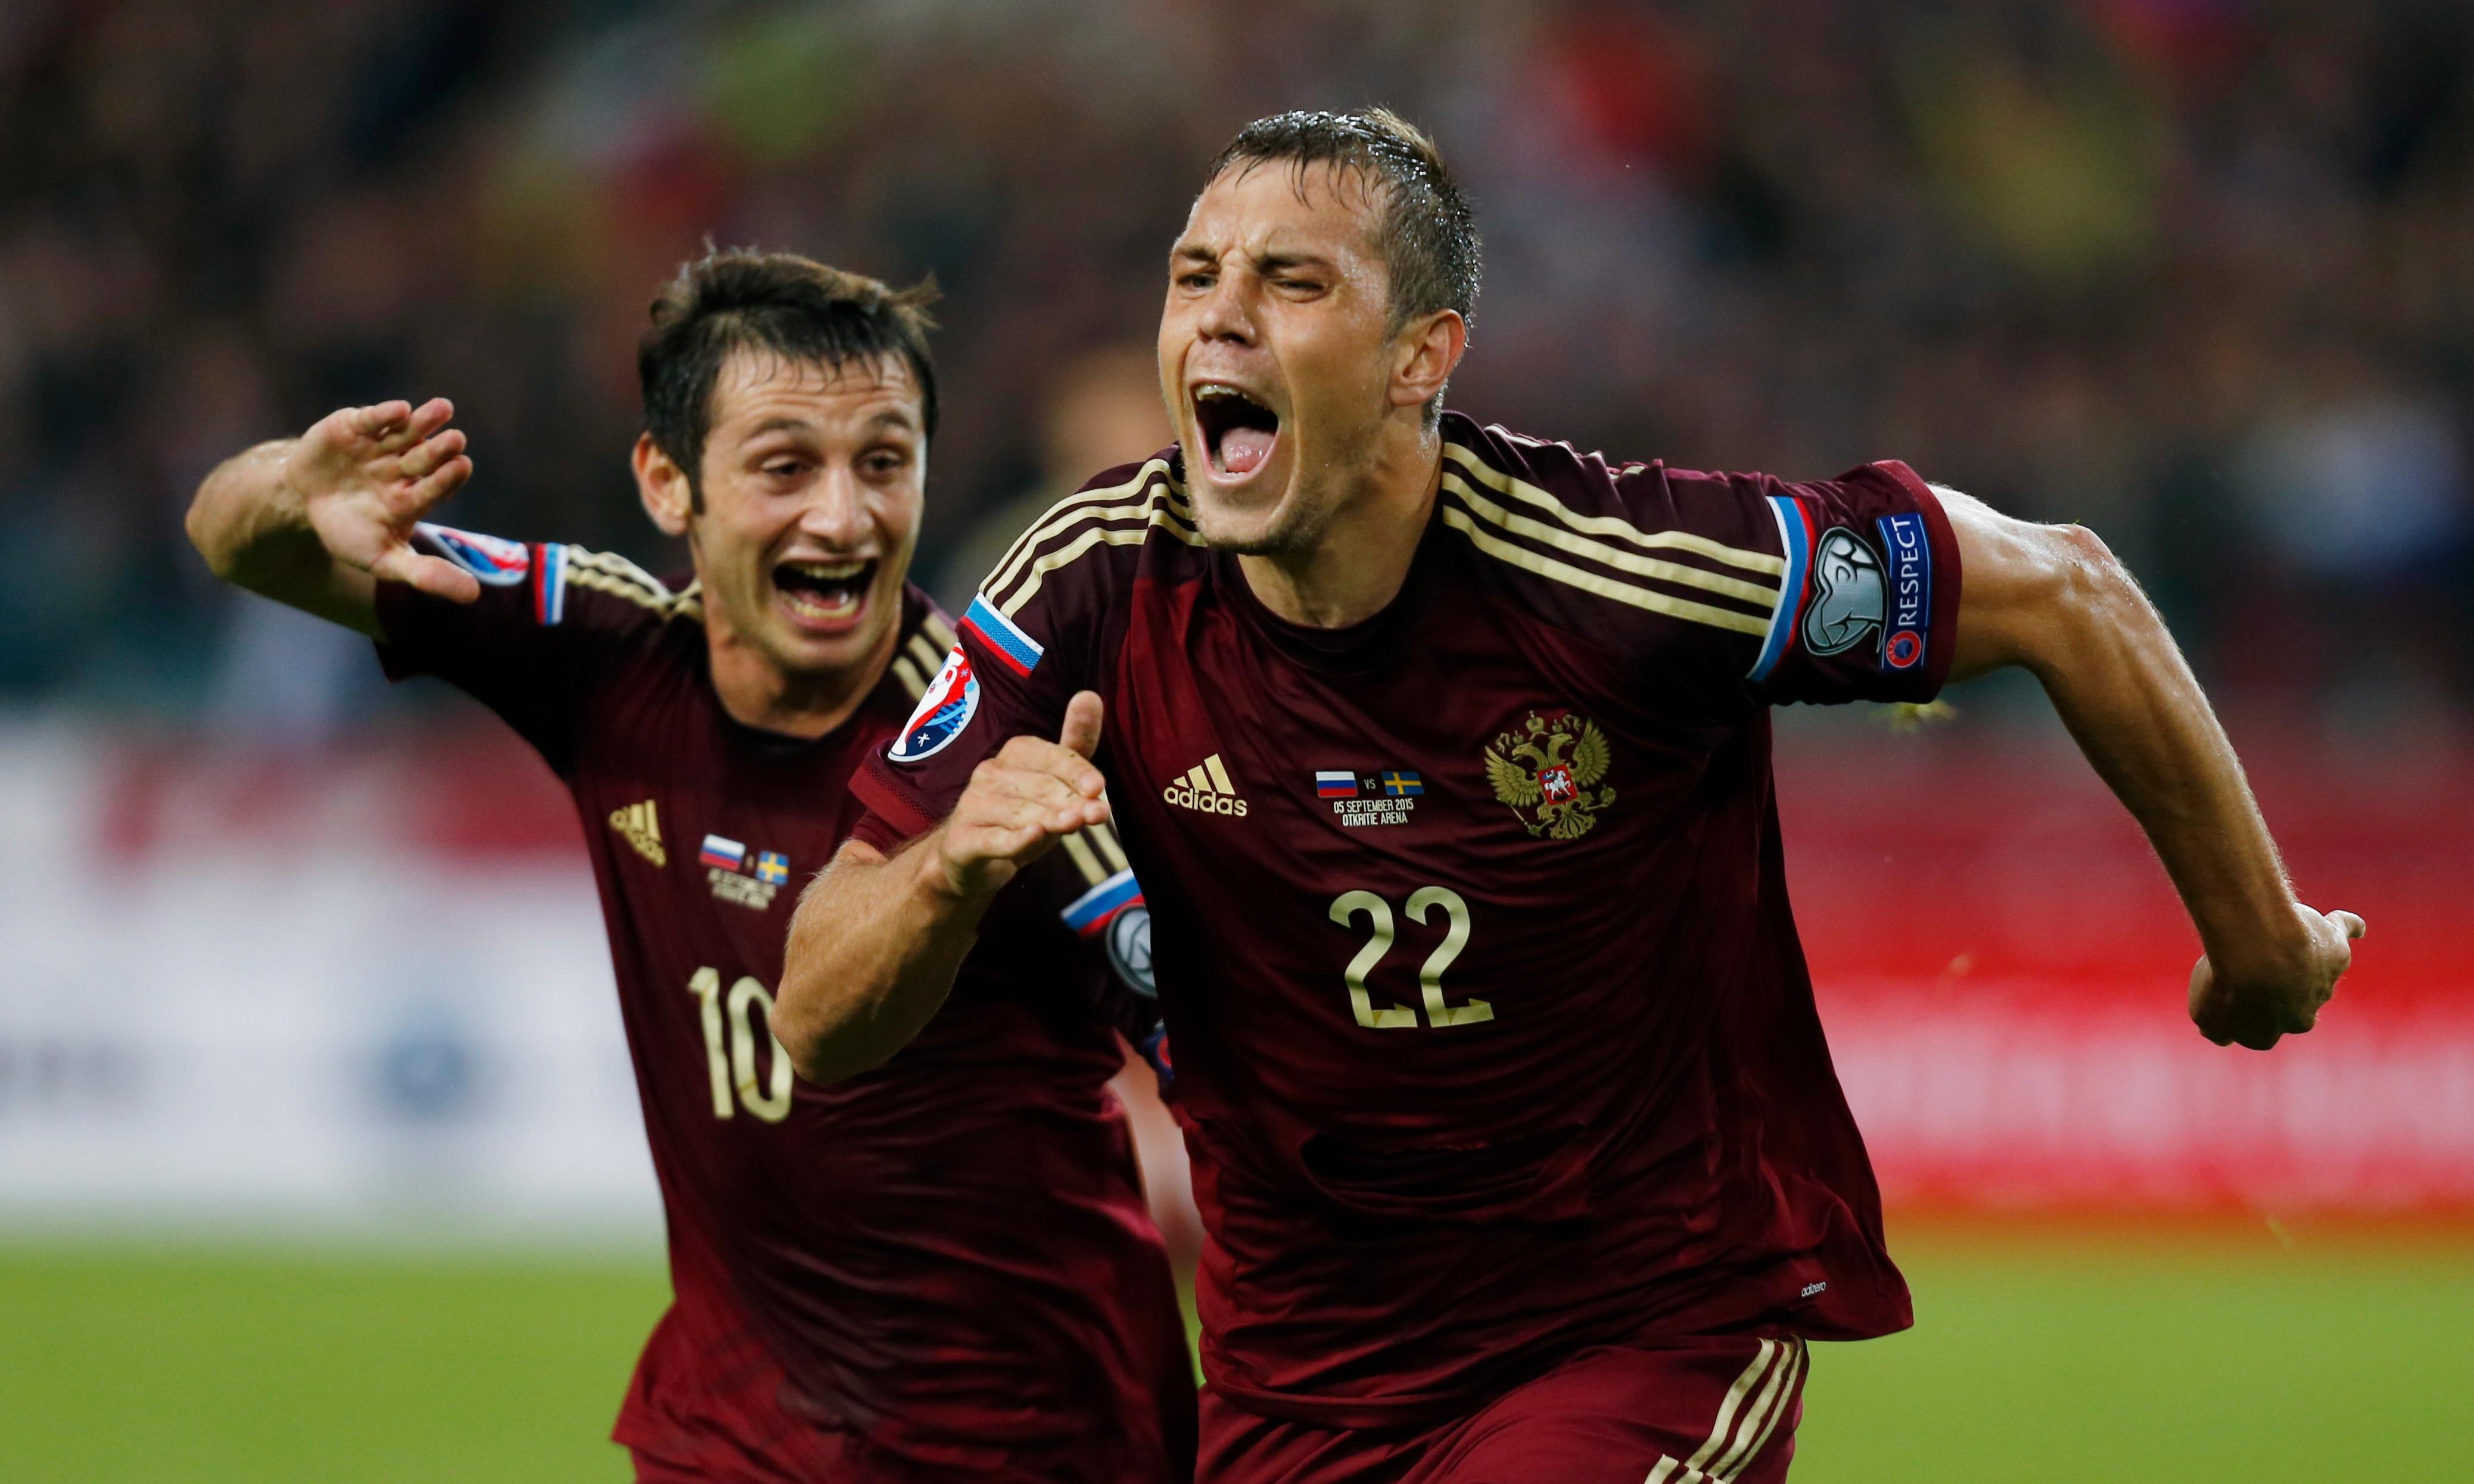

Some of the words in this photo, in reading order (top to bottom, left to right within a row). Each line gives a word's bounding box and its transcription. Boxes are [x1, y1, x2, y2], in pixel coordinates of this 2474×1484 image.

[1891, 517, 1919, 626] RESPECT
[1364, 779, 1376, 790] VS
[1163, 786, 1248, 817] adidas
[1333, 801, 1345, 814] 05
[1346, 799, 1394, 813] SEPTEMBER
[1395, 798, 1414, 811] 2015
[1342, 813, 1378, 826] OTKRITIE
[1381, 811, 1408, 825] ARENA
[1329, 886, 1495, 1028] 22
[686, 966, 793, 1122] 10
[1801, 1282, 1826, 1298] adizero
